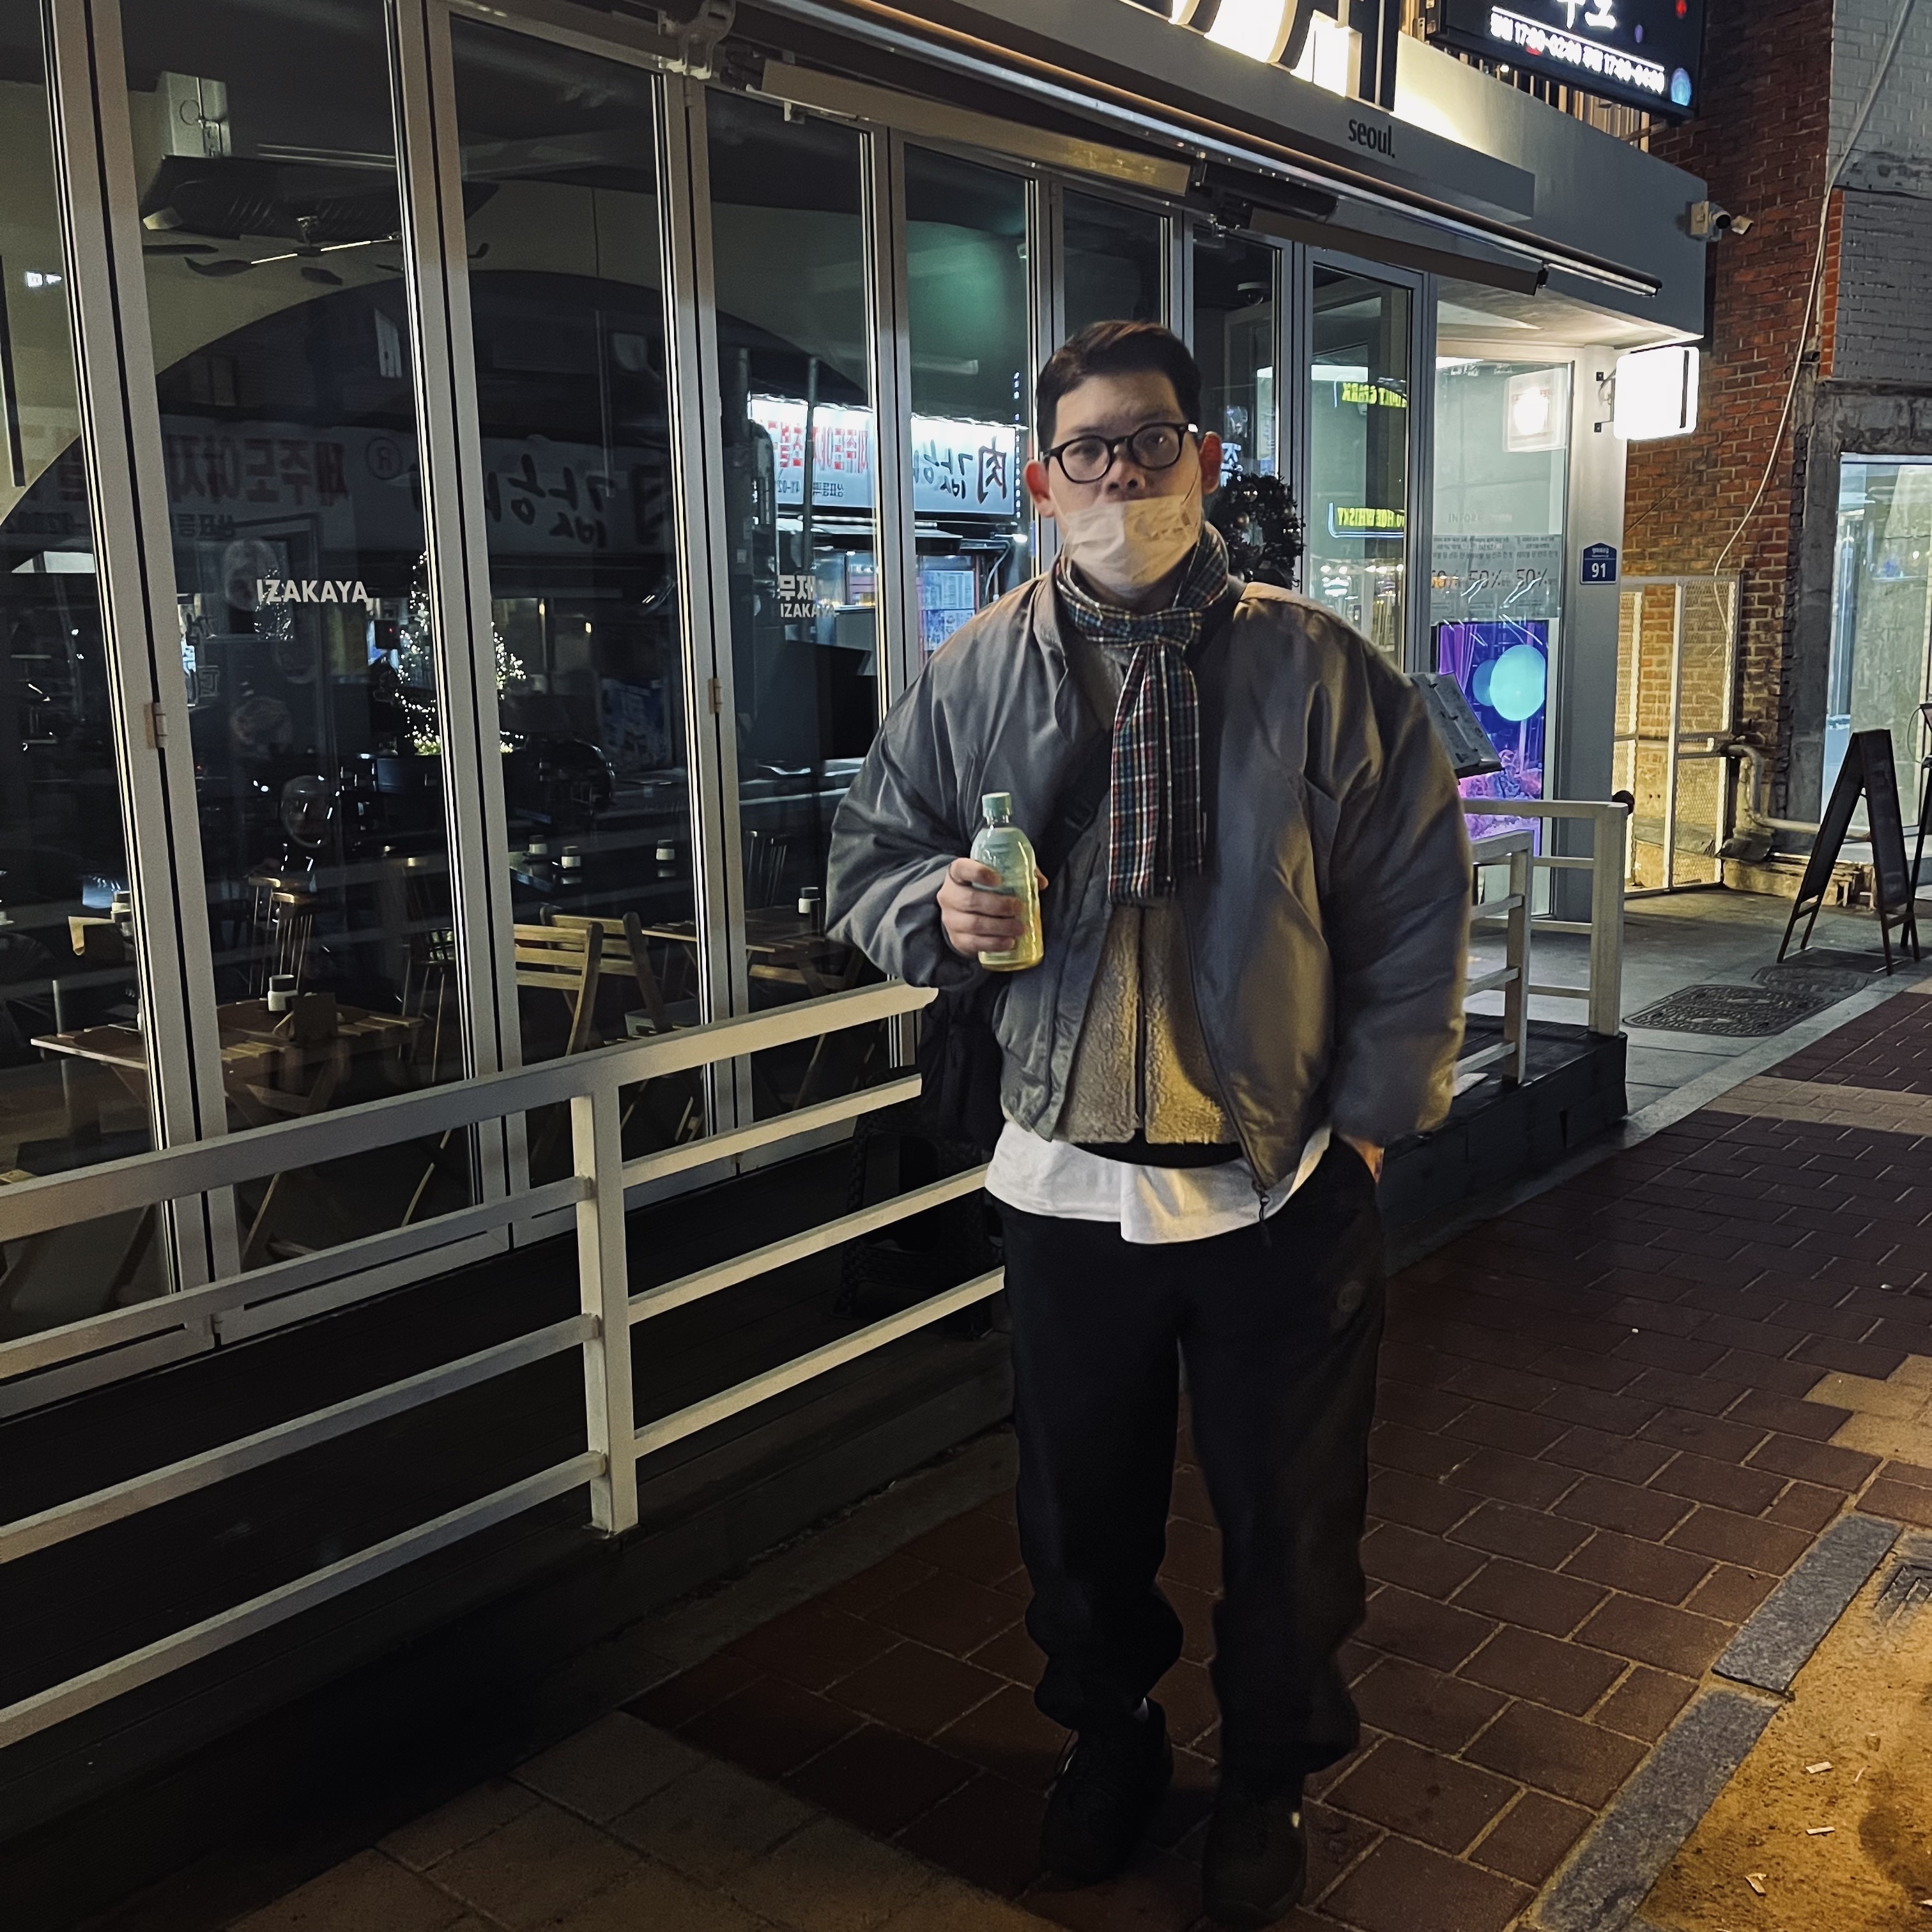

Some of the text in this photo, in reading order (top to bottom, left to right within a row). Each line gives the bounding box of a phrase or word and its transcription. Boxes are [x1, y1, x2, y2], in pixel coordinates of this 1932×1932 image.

[1348, 118, 1395, 158] seoul.
[1591, 562, 1606, 578] 91
[256, 579, 369, 604] IZAKAYA
